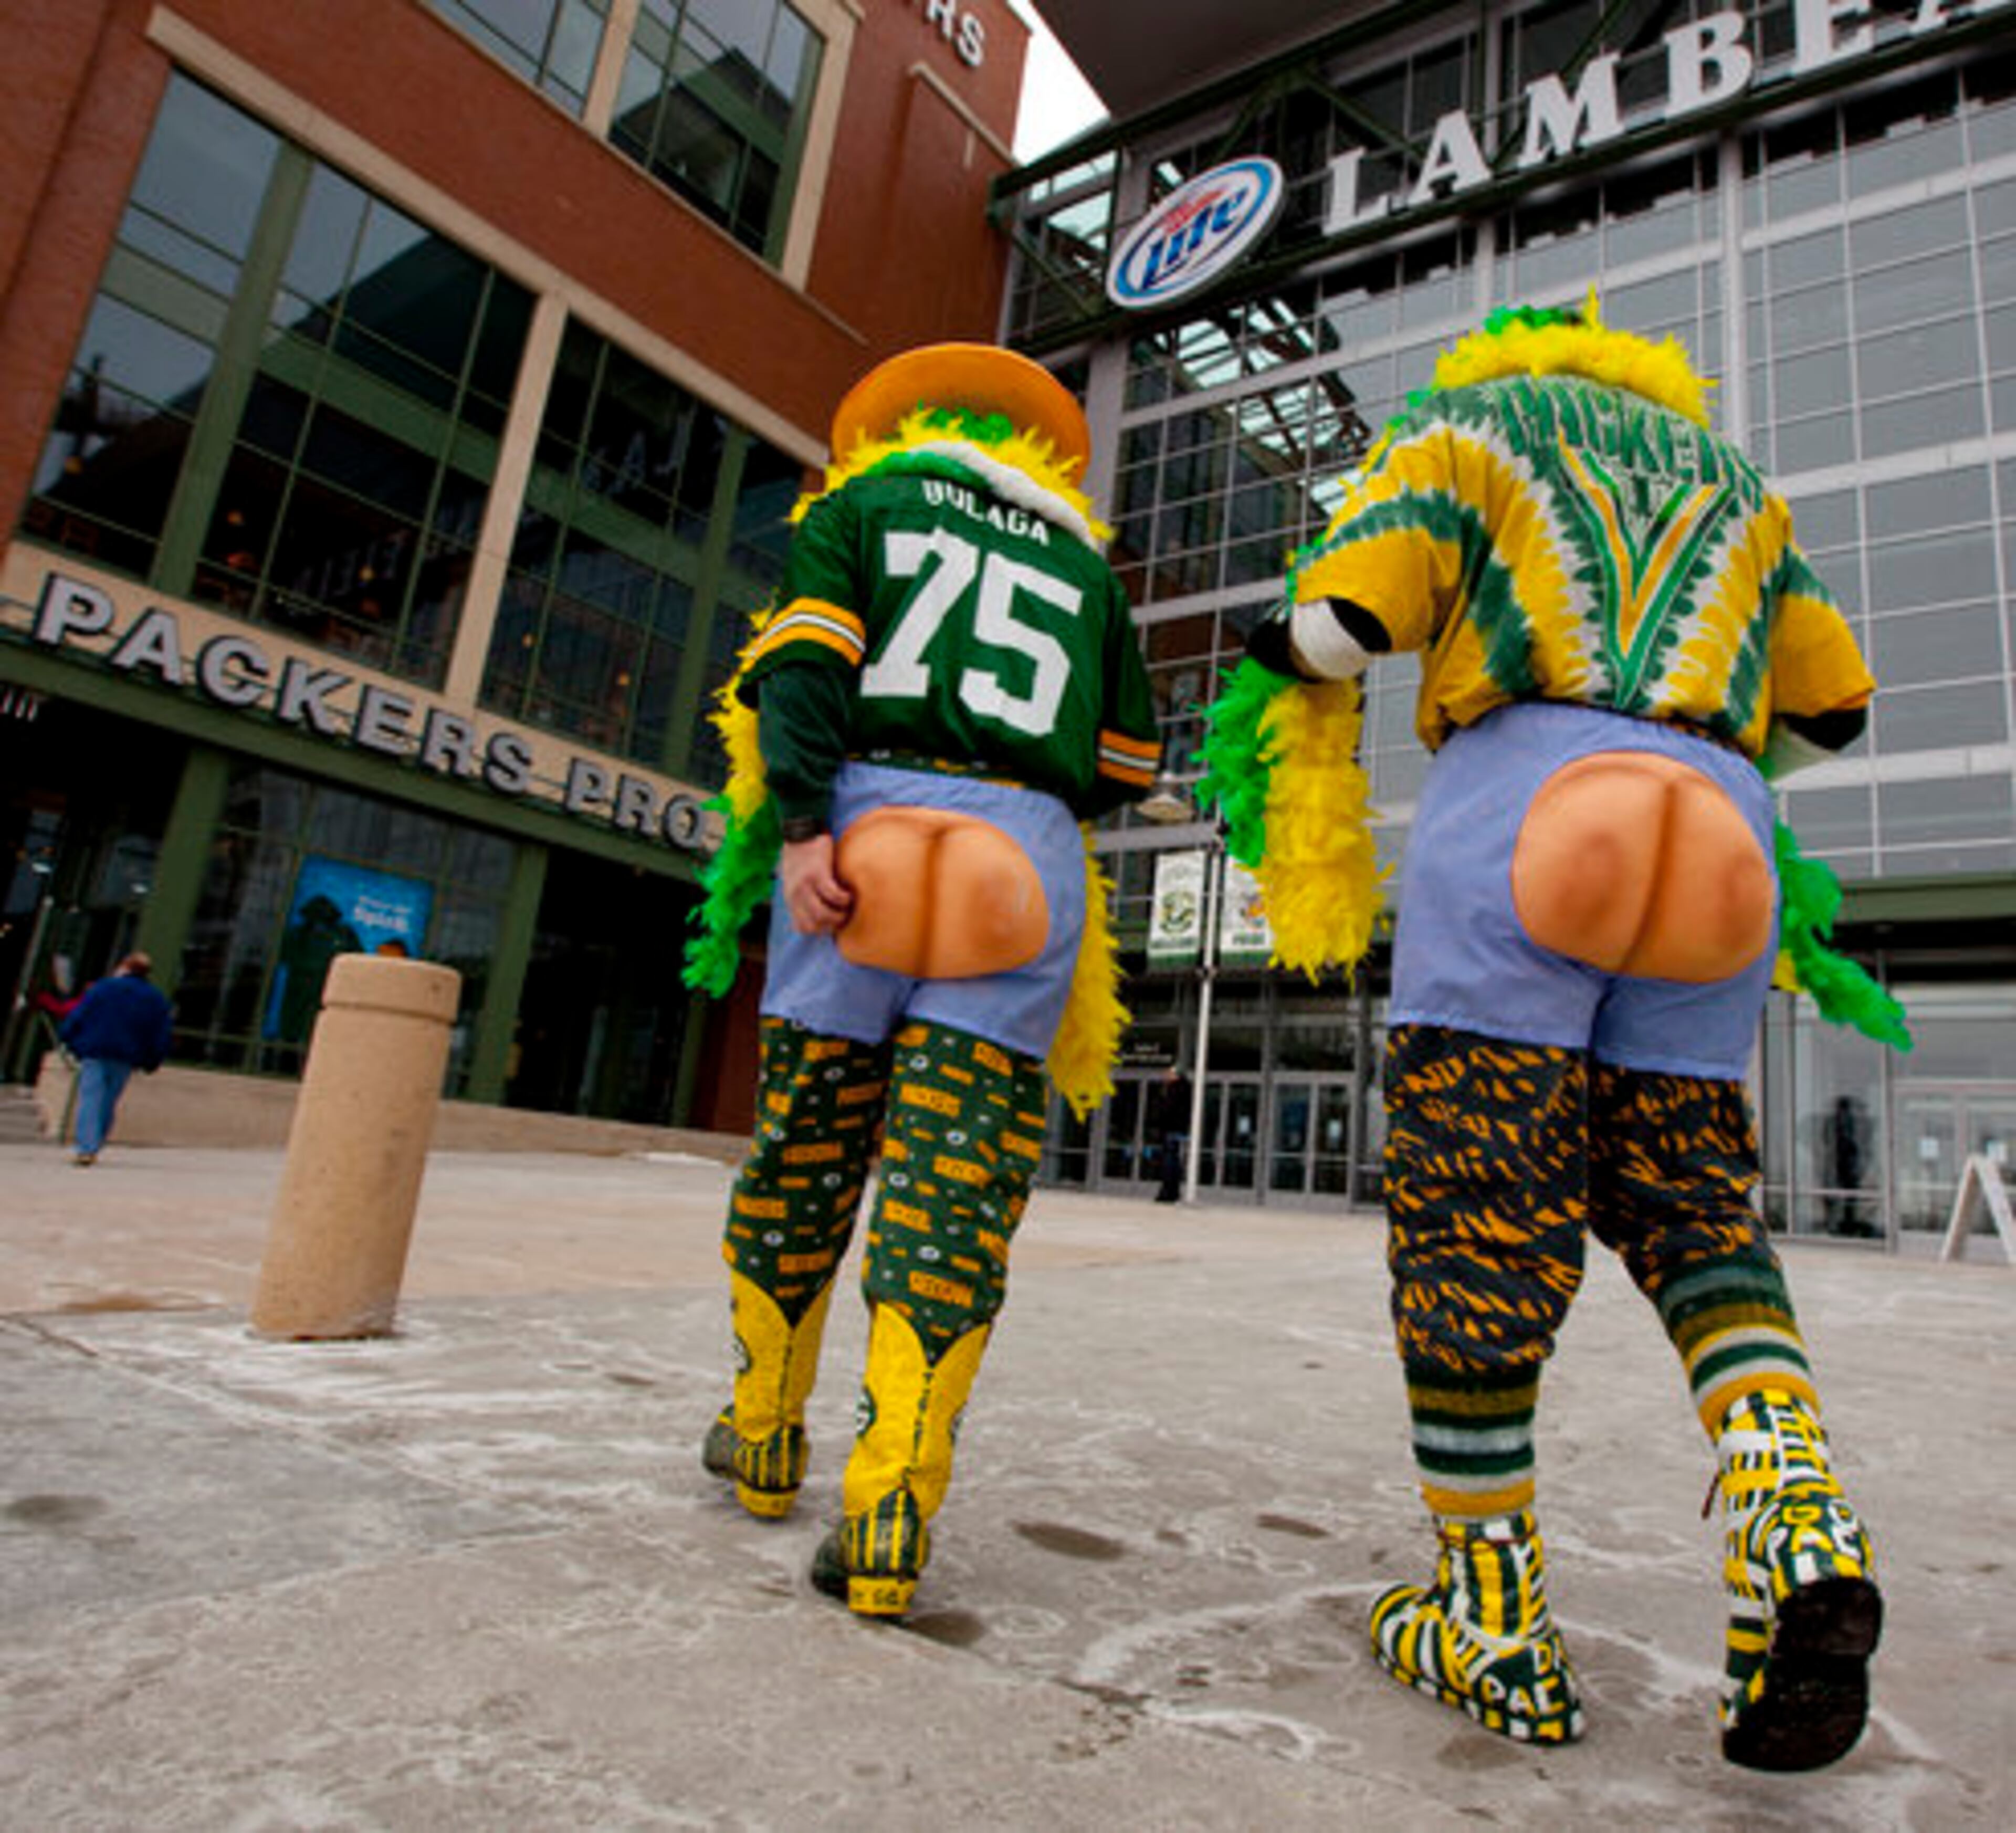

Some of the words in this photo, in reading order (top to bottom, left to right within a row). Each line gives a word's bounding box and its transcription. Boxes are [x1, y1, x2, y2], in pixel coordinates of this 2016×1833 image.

[33, 570, 533, 795] PACKERS
[563, 757, 707, 850] PRO
[860, 525, 1083, 738] 75
